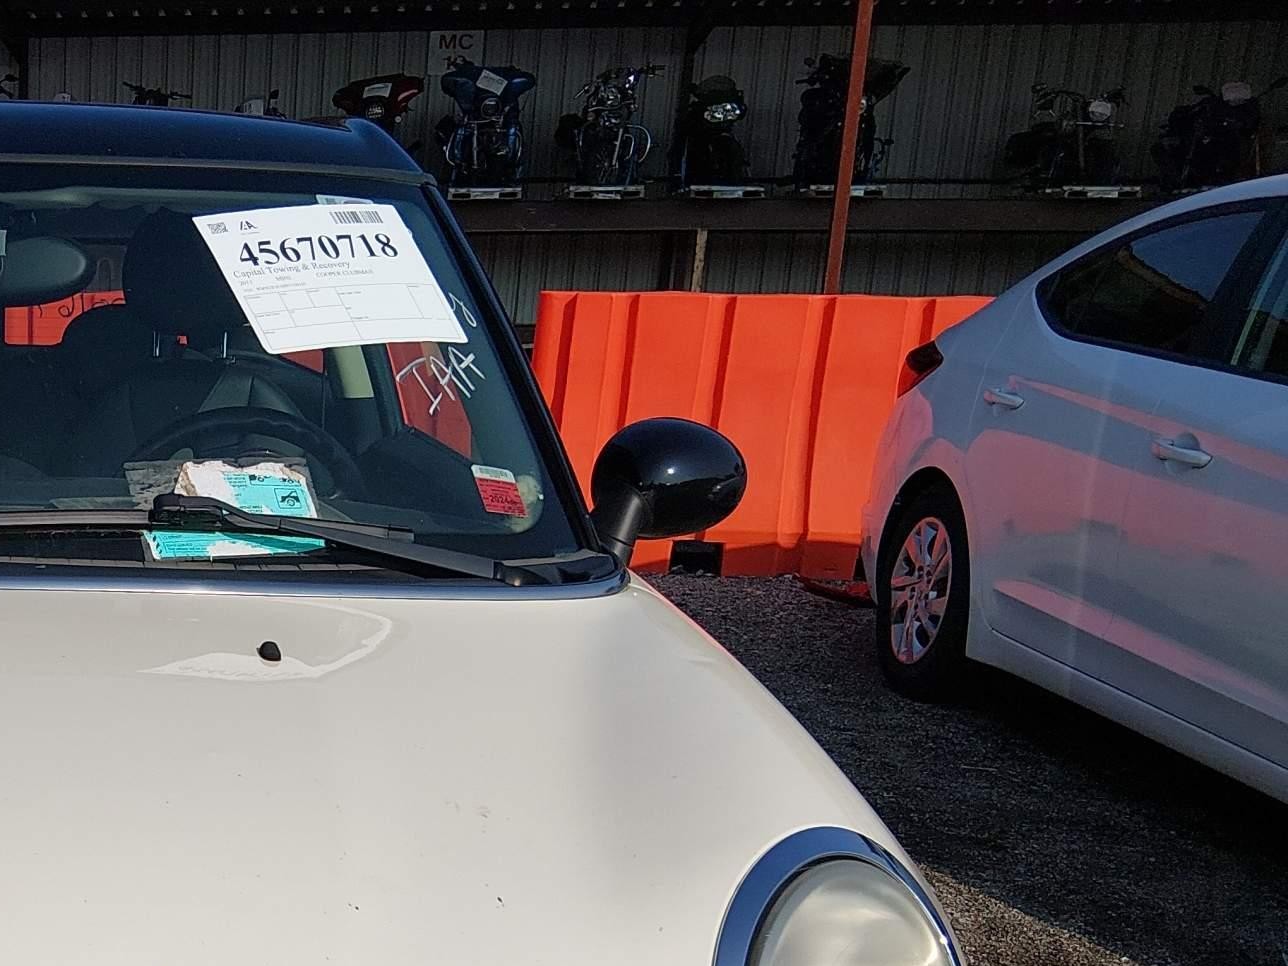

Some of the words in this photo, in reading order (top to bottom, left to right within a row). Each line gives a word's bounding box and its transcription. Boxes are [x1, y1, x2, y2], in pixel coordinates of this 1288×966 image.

[439, 34, 473, 50] MC
[239, 232, 399, 266] 45670718
[234, 267, 265, 278] Capital
[265, 264, 301, 273] Towing
[311, 260, 350, 270] Recovery
[396, 346, 486, 416] IAA
